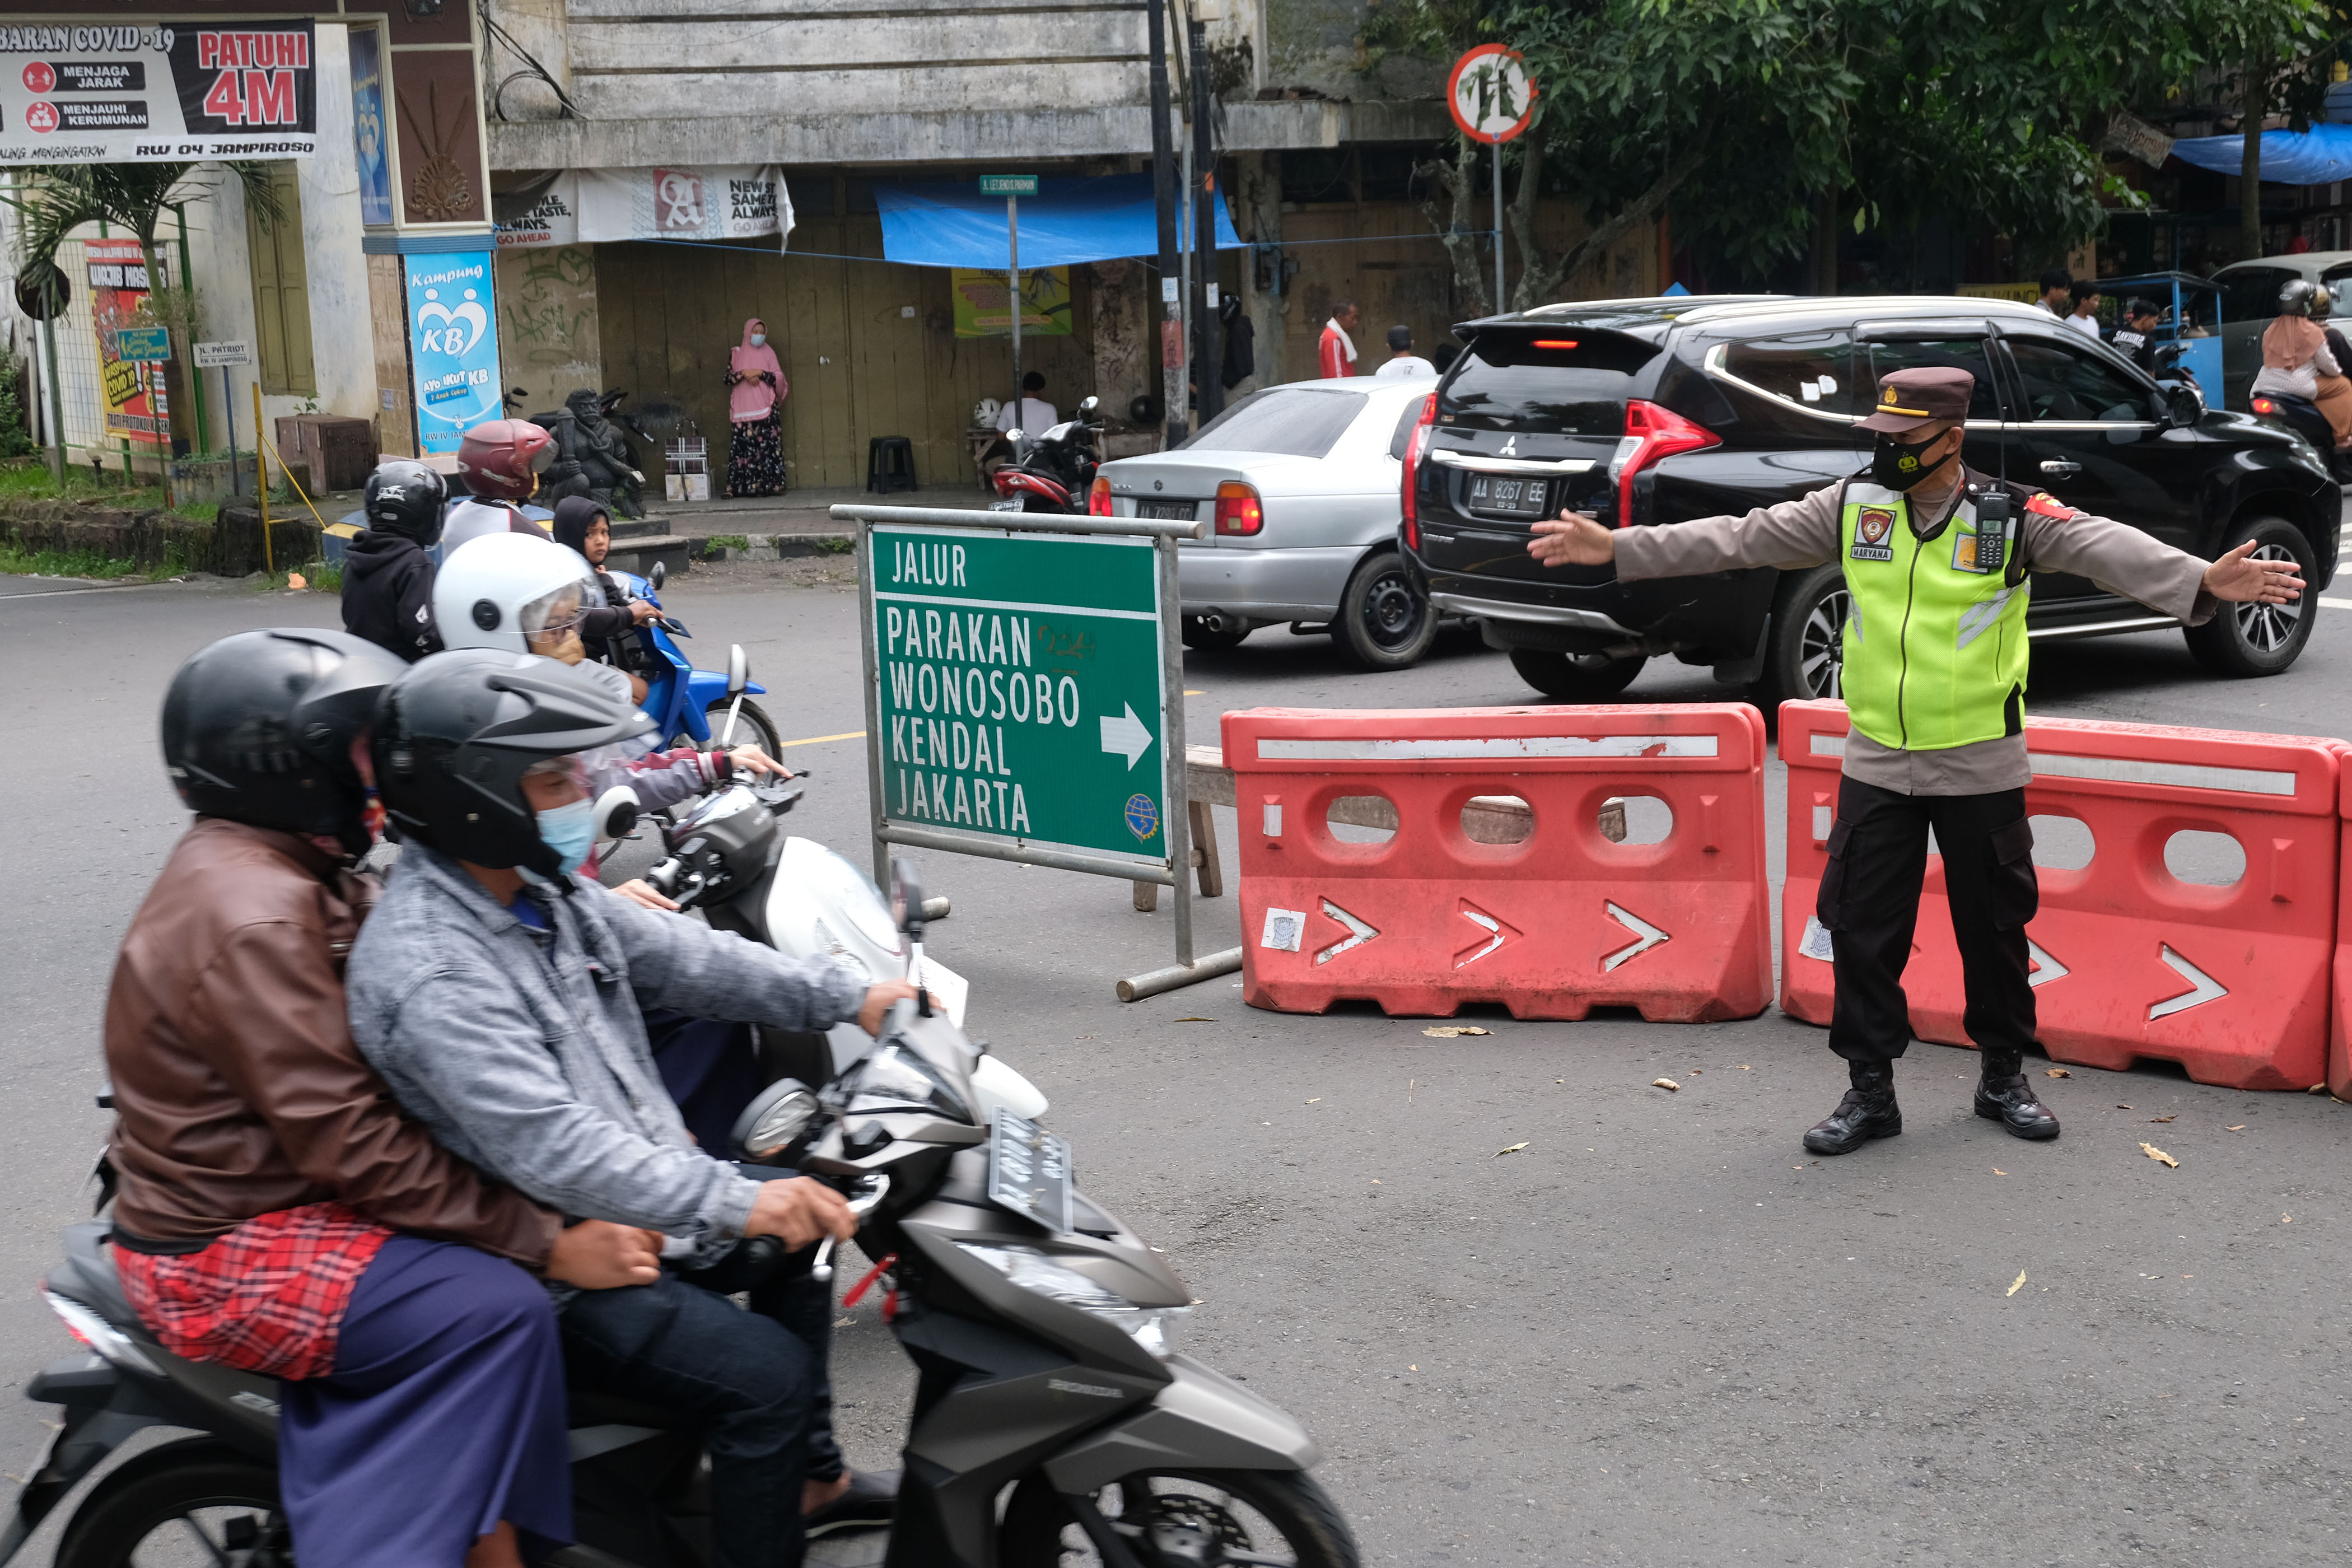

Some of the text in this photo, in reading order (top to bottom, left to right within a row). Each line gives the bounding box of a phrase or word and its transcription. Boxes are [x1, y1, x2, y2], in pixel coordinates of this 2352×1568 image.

[197, 31, 309, 69] PATUHI
[63, 66, 130, 77] MENJAGA
[77, 77, 123, 88] JARAK
[203, 69, 297, 125] 4M
[63, 104, 127, 115] MENJAUHI
[68, 114, 147, 126] KERUMUNAN
[137, 142, 315, 156] RW 04 JAMPIROSO
[730, 179, 763, 193] NEW
[731, 193, 766, 206] SAME
[734, 221, 752, 231] GO
[497, 232, 551, 245] GO AHEAD
[91, 265, 166, 288] WAJIB MASR
[412, 264, 483, 287] Kampung
[212, 344, 245, 353] PATRIOT
[422, 327, 465, 355] KB
[107, 374, 127, 396] COVID
[128, 368, 136, 386] 19
[468, 368, 489, 386] KB
[122, 414, 150, 431] PROTOKOL
[425, 432, 438, 441] RW
[1473, 478, 1546, 502] AA 8267 EE
[892, 541, 966, 587] JALUR
[886, 606, 1031, 667] PARAKAN
[889, 661, 1080, 727] WONOSOBO
[892, 715, 1011, 776] KENDAL
[897, 769, 1031, 833] JAKARTA
